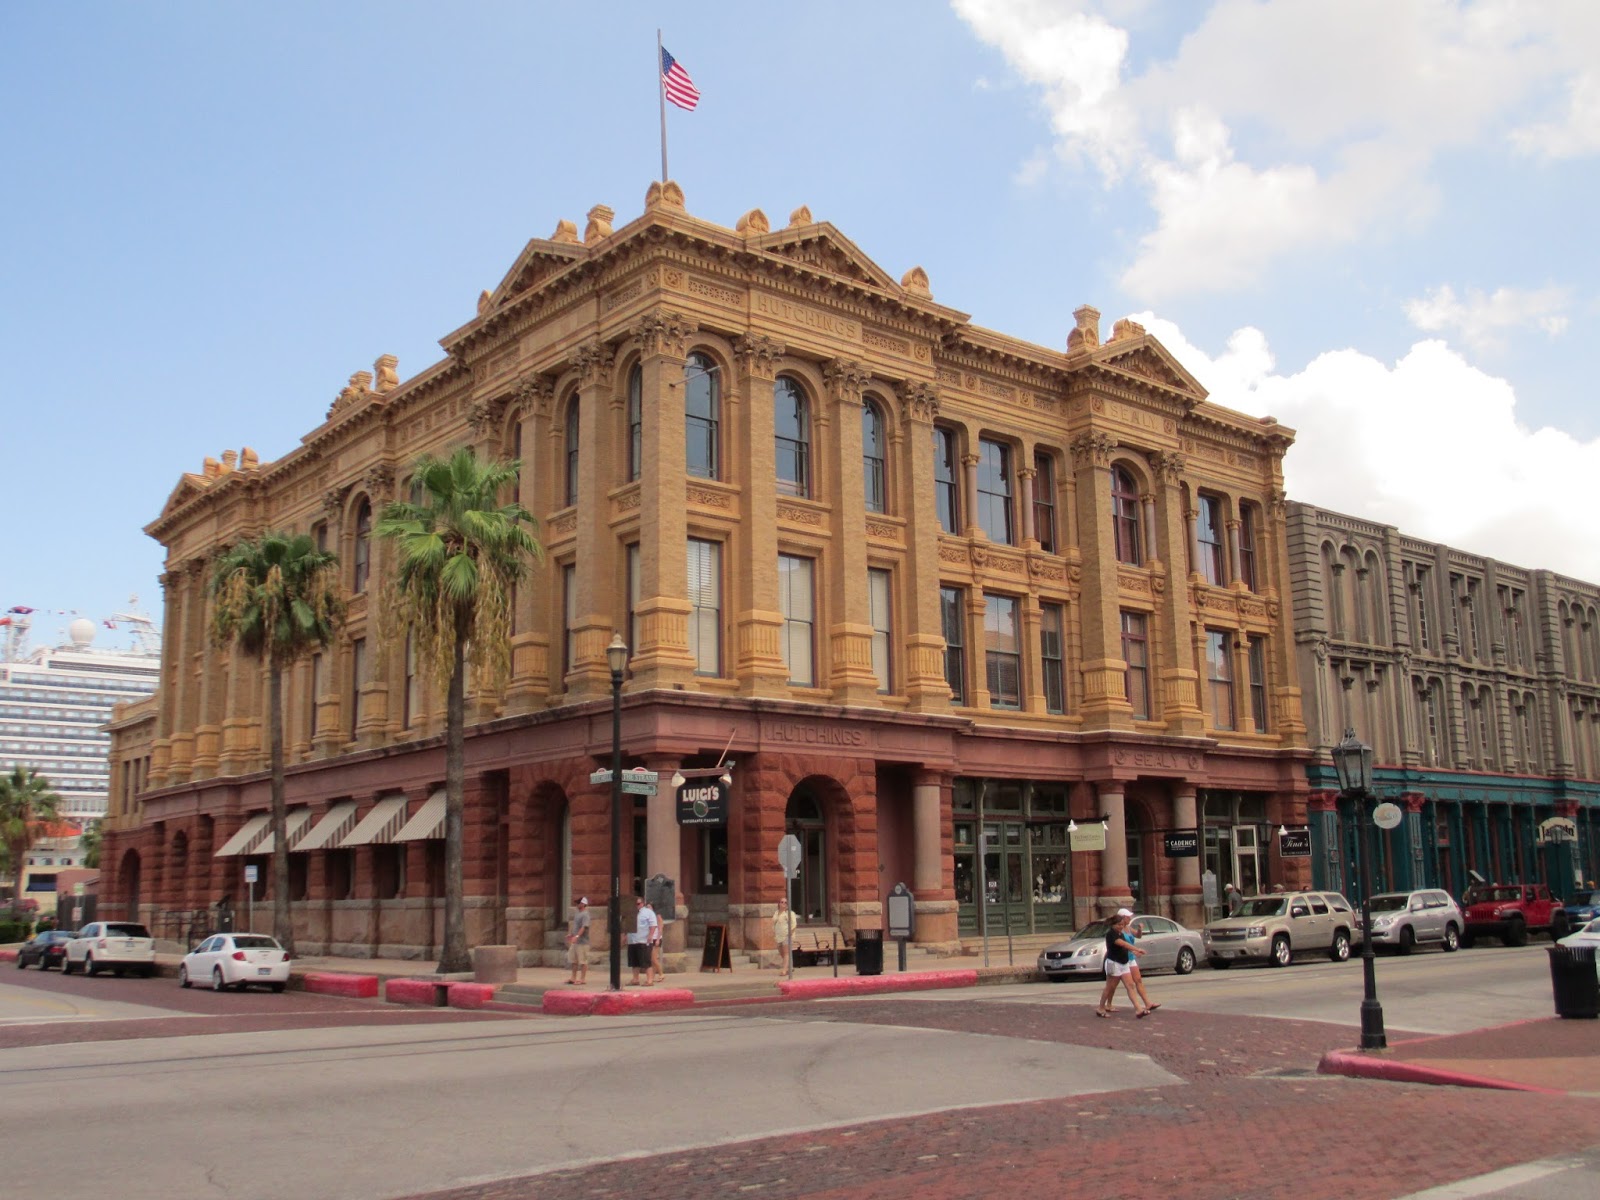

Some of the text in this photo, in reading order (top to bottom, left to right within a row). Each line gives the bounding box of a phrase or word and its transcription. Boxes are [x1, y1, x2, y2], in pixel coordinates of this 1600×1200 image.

[759, 296, 856, 338] HUTCHINGS
[1110, 405, 1158, 430] SEALY
[772, 723, 862, 746] HUTCHINGS
[1134, 752, 1180, 768] SEALY
[622, 773, 634, 781] THE
[635, 774, 657, 783] STRAND
[682, 785, 720, 802] LUIGI'S
[1170, 839, 1197, 847] CADENCE
[1282, 836, 1309, 848] Tina's
